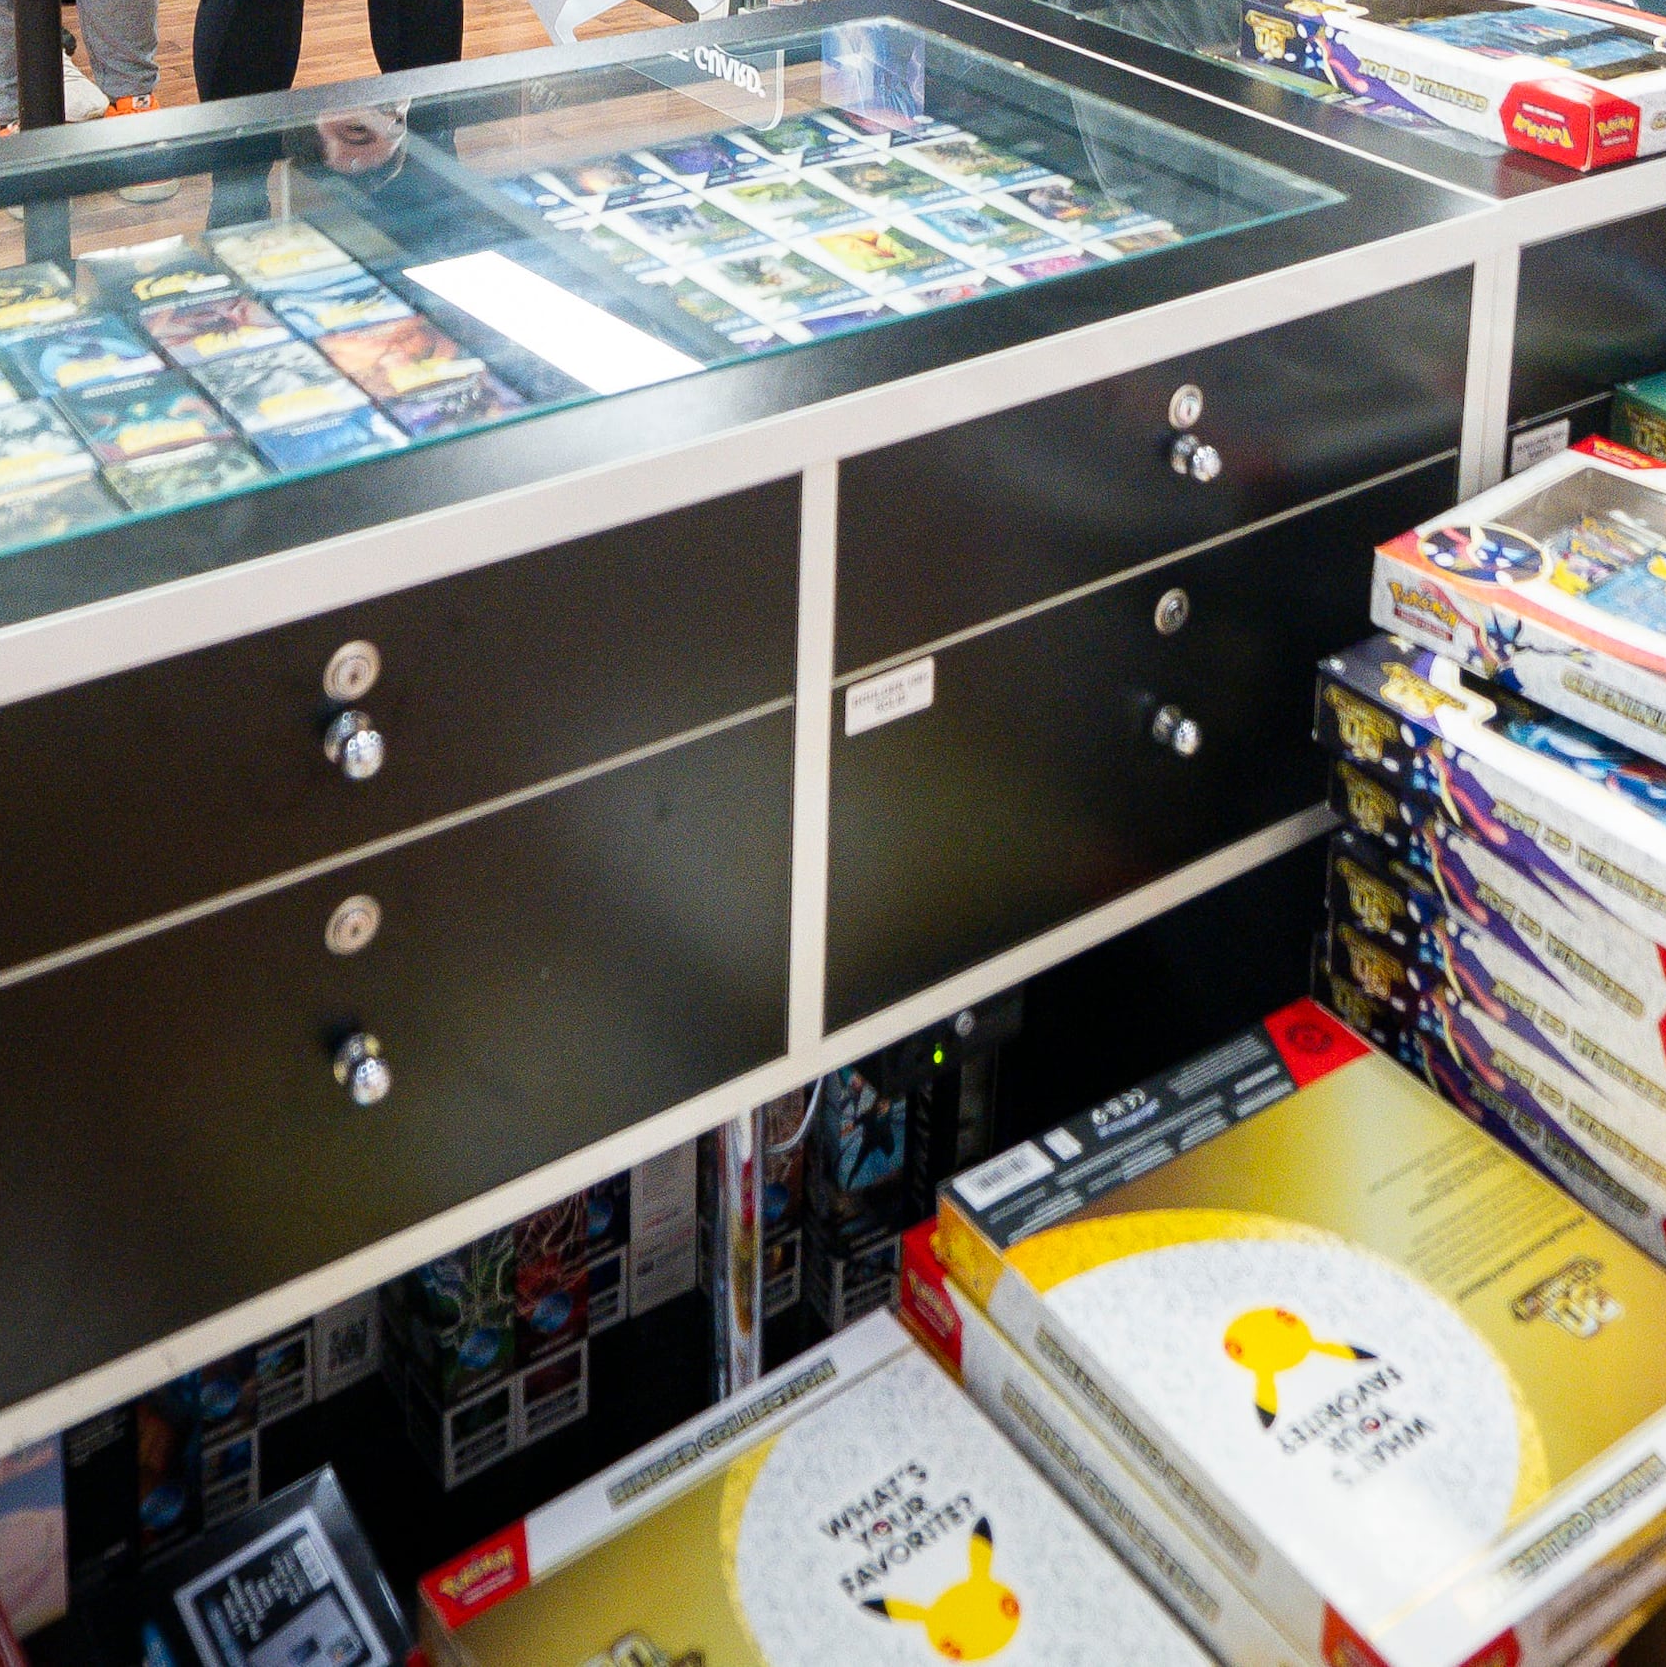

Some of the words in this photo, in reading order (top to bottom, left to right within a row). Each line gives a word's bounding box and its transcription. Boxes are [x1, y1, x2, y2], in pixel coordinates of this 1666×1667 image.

[1357, 57, 1390, 82] BOX
[1412, 72, 1489, 113] GRENINJA
[1511, 111, 1575, 149] Pokémon
[1390, 580, 1458, 627] Pokémon
[605, 1442, 703, 1512] BINDER
[697, 1356, 838, 1452] COLLECTION
[1280, 1362, 1405, 1458] FAVORITE?
[819, 1458, 930, 1542] WHAT'S
[854, 1494, 930, 1551] YOUR
[839, 1490, 979, 1598] FAVORITE?
[438, 1545, 516, 1600] Pokémon
